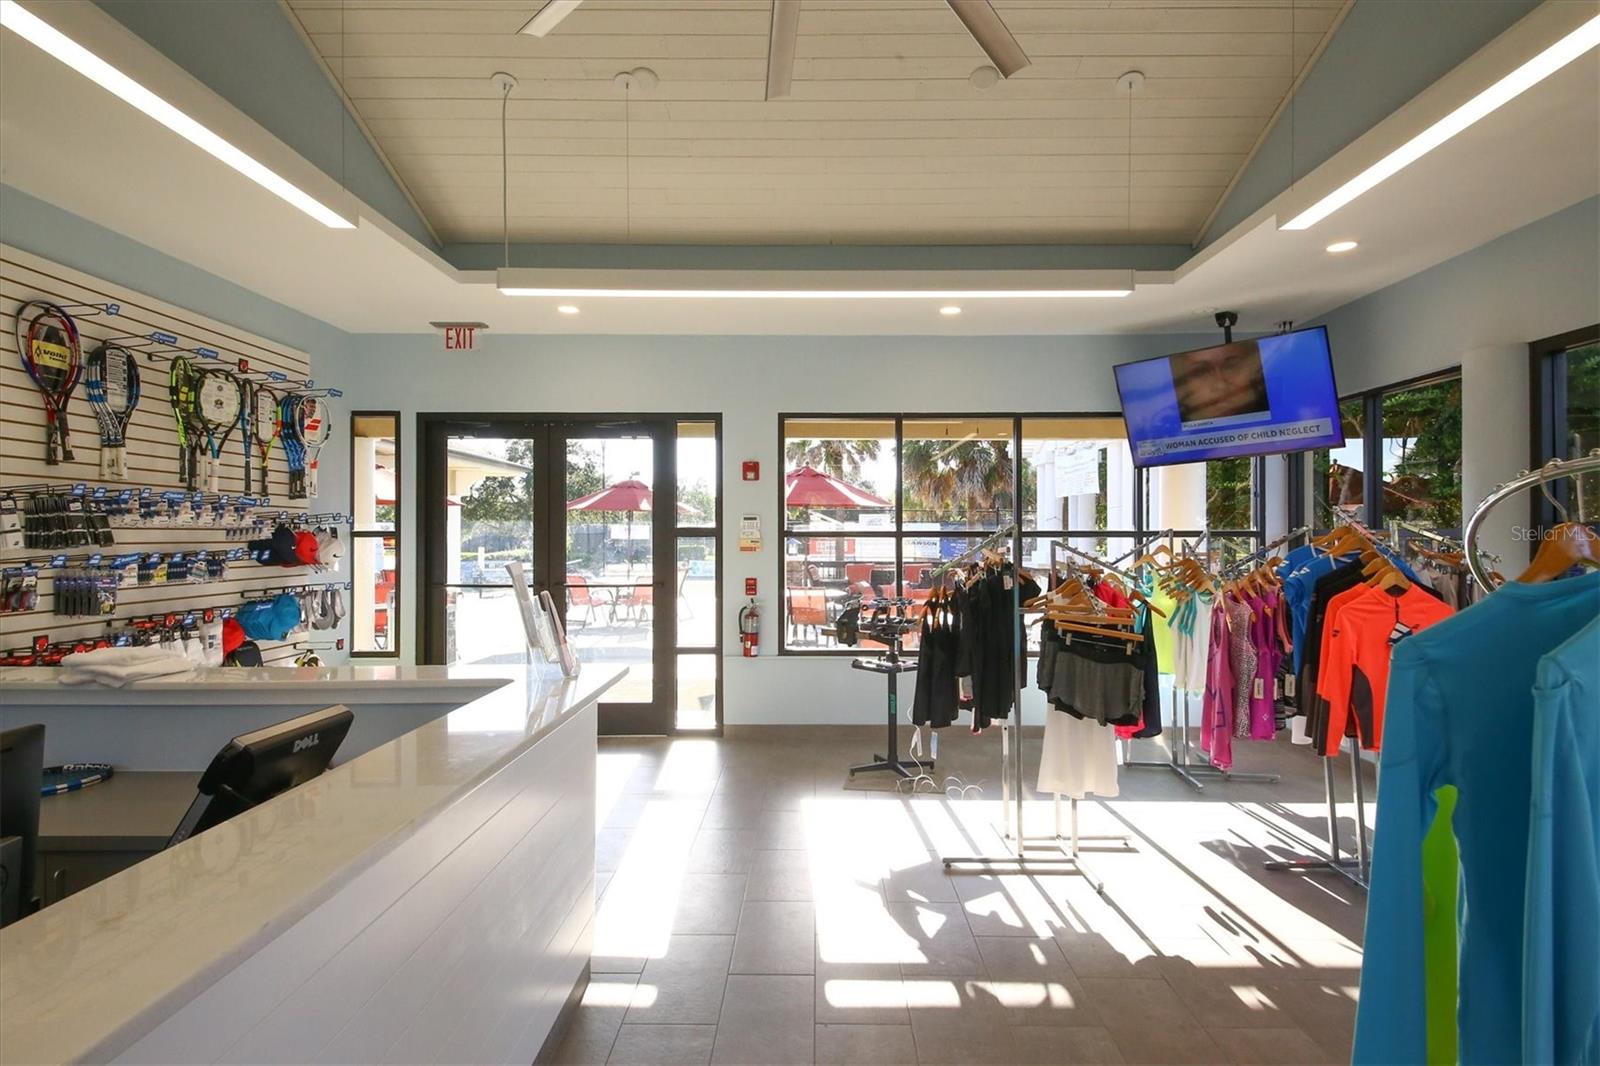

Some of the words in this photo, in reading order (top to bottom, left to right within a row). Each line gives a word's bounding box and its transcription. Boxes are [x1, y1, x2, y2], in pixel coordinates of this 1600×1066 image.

[446, 327, 475, 350] EXIT
[1165, 439, 1197, 450] WOMAN
[1198, 435, 1235, 446] ACCUSED
[1237, 433, 1249, 441] OF
[1251, 429, 1277, 440] CHILD
[1279, 424, 1321, 436] NEGLECT
[293, 732, 320, 753] DELL
